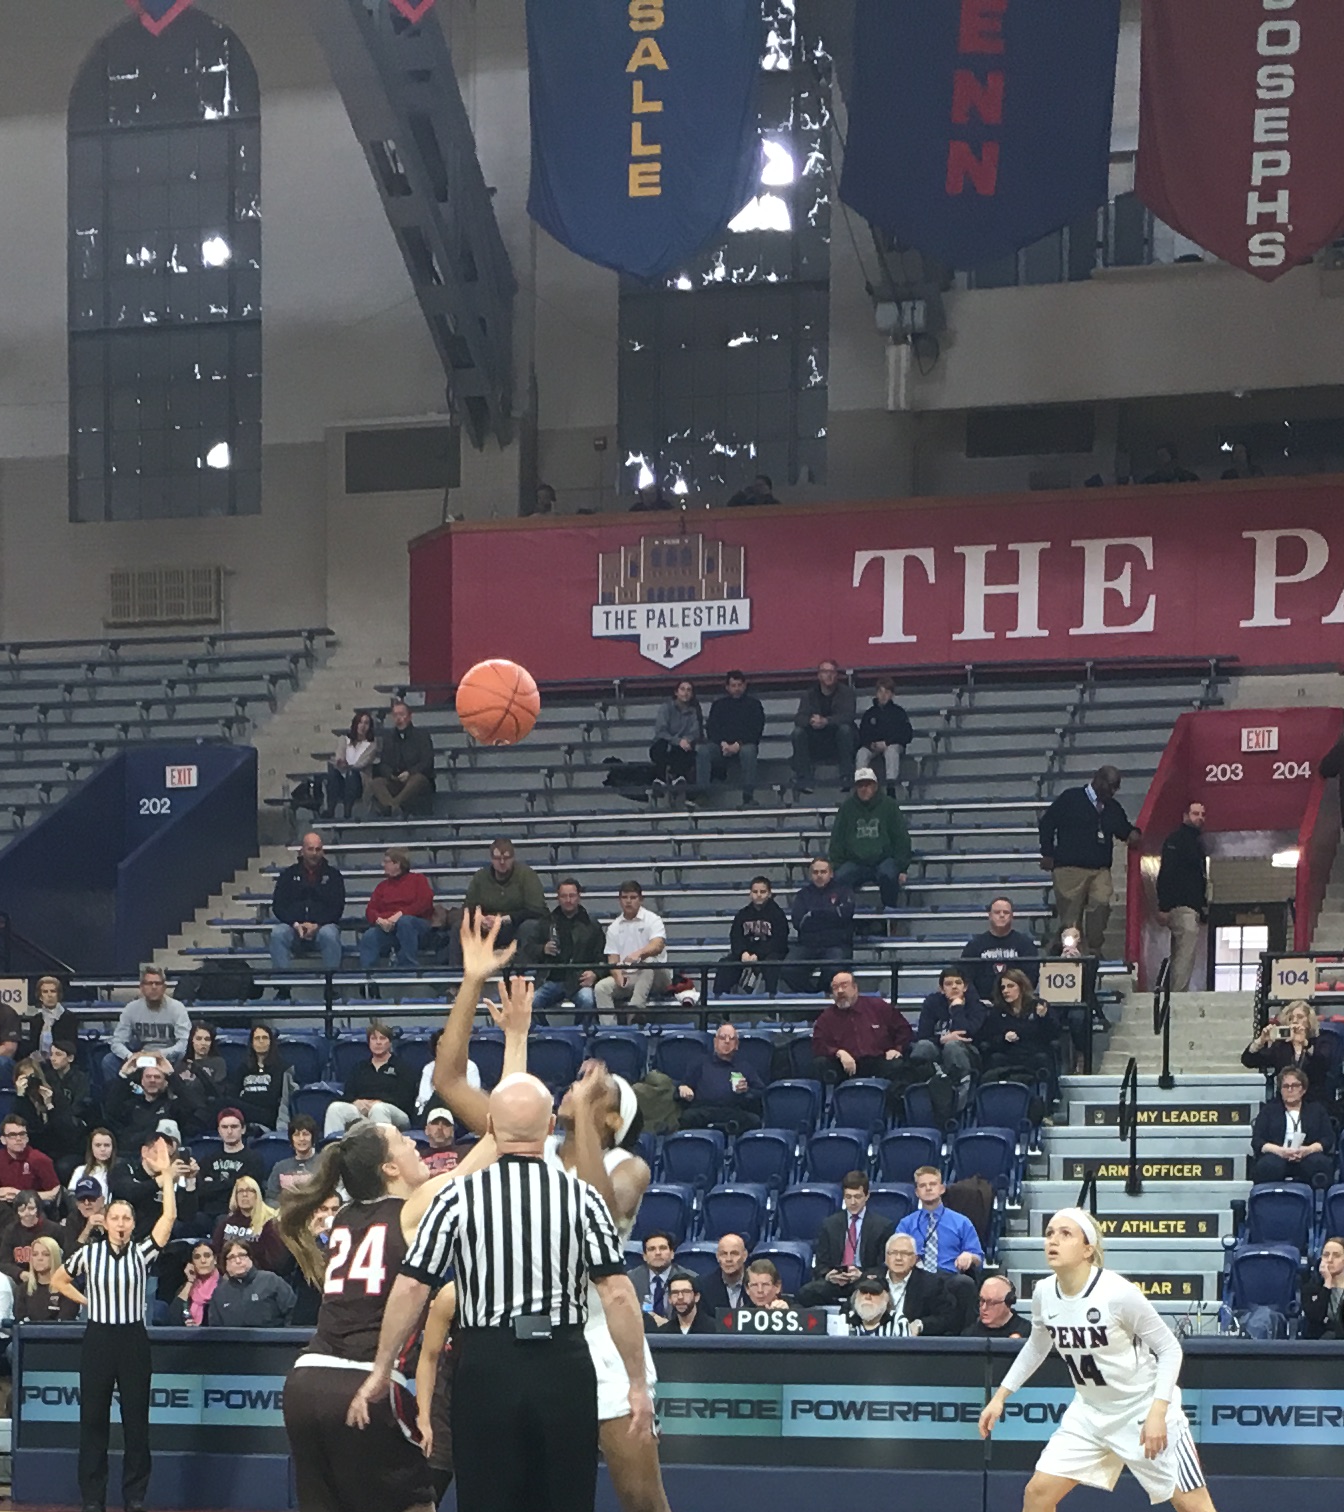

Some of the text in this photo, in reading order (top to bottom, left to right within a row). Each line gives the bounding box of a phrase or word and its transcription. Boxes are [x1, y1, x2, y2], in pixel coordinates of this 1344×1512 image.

[945, 0, 1006, 195] ENN
[1246, 0, 1302, 268] OSEPH'S
[853, 535, 1156, 646] THE
[603, 605, 739, 631] THE PALESTRA
[1246, 729, 1274, 749] EXIT
[170, 767, 193, 786] EXIT
[1206, 761, 1312, 782] 203 204
[139, 797, 171, 815] 202
[1045, 973, 1076, 989] 103
[1277, 970, 1309, 986] 104
[1162, 1111, 1218, 1122] LEADER
[1142, 1165, 1202, 1176] OFFICER
[1121, 1221, 1186, 1233] ATHLETE
[323, 1222, 388, 1296] 24
[737, 1310, 804, 1333] POSS.
[1064, 1353, 1107, 1387] 14
[790, 1400, 985, 1423] POWERADE
